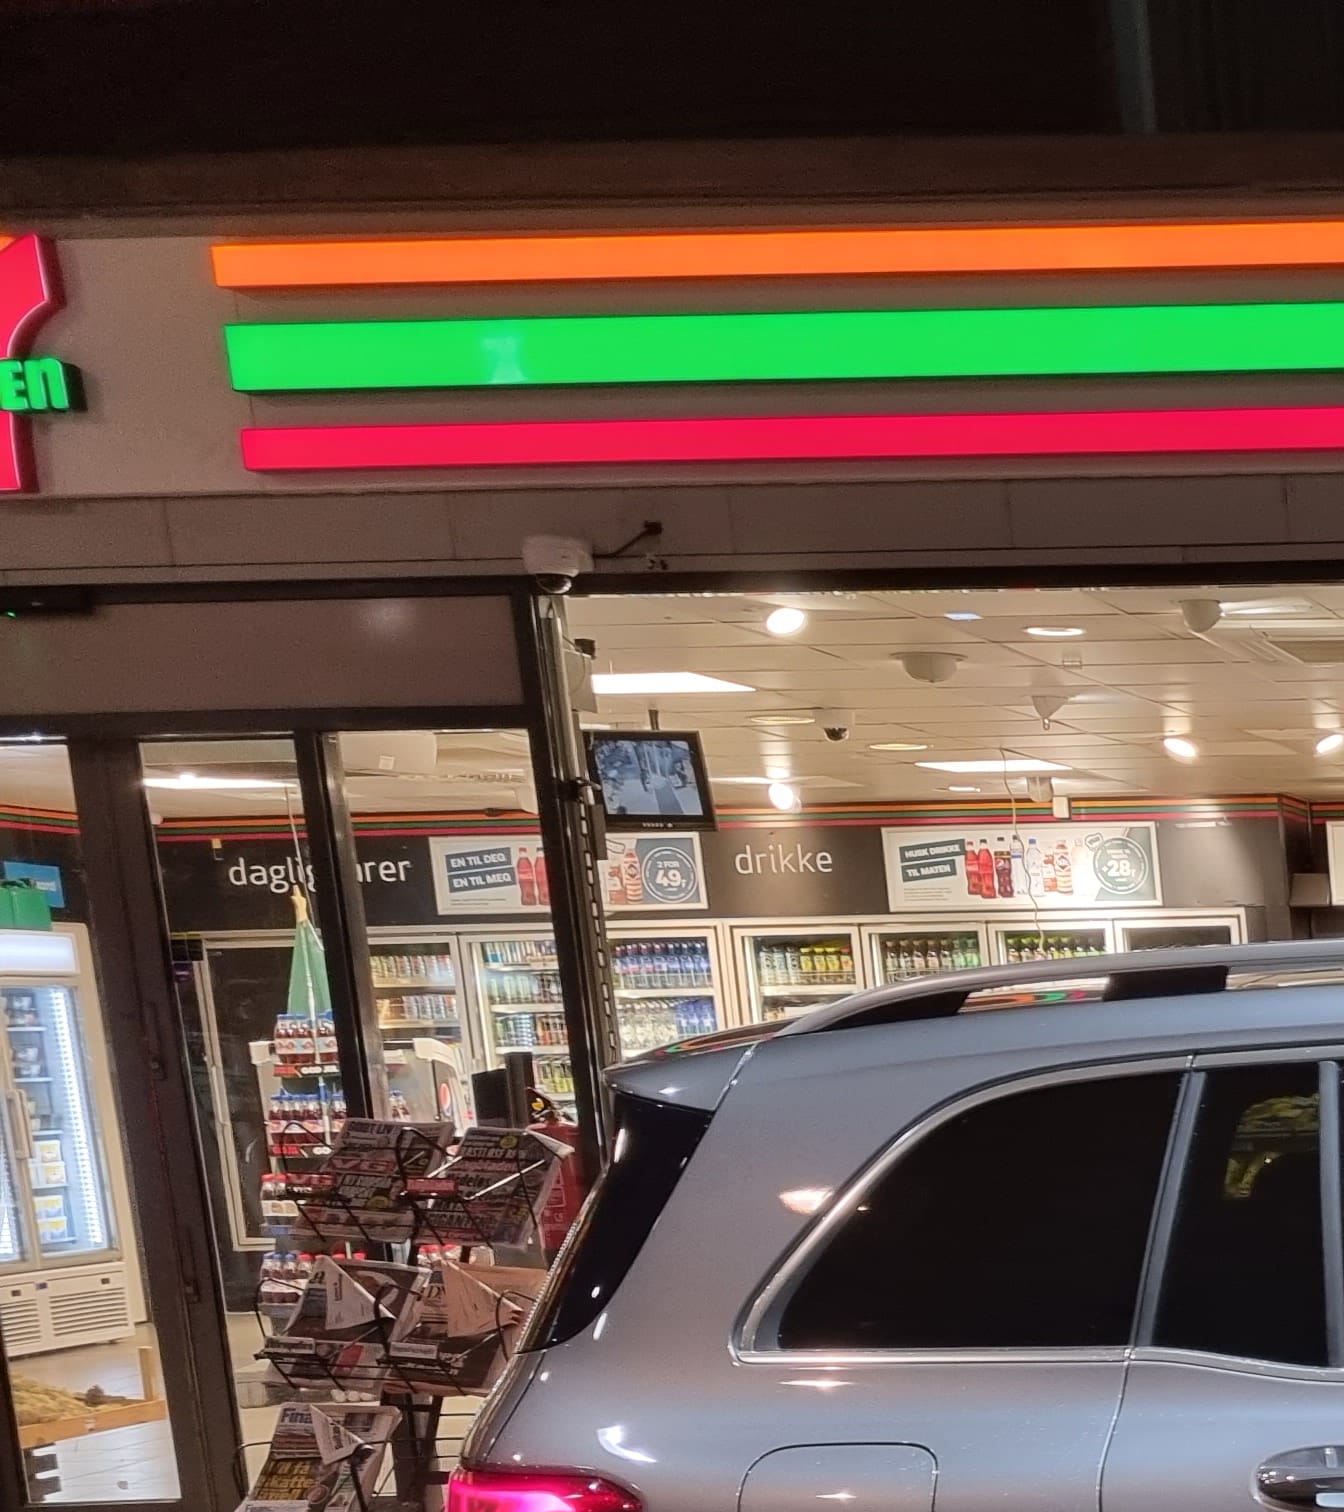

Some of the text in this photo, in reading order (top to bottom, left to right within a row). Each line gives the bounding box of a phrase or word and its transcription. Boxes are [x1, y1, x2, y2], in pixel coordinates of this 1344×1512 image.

[450, 852, 506, 868] EN TIL DEG
[734, 844, 833, 875] drikke
[453, 872, 512, 888] EN TIL MEG
